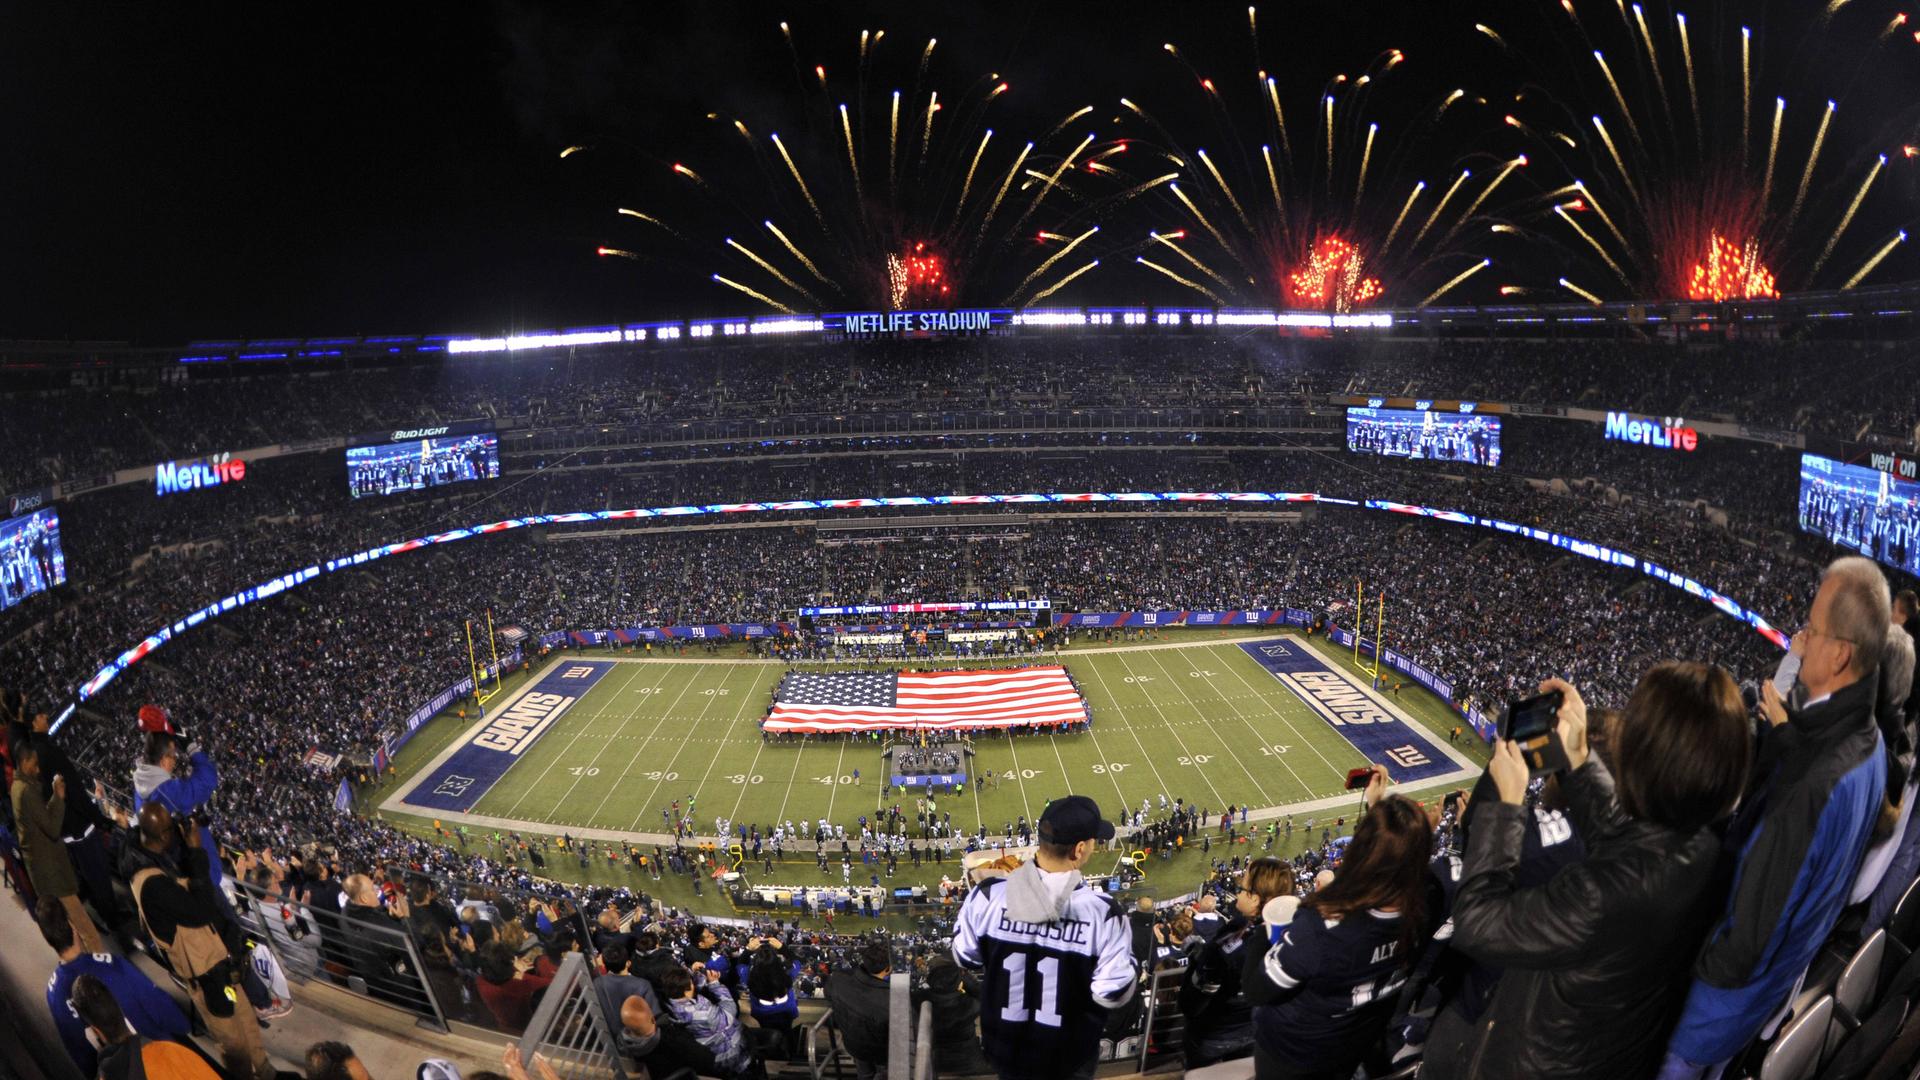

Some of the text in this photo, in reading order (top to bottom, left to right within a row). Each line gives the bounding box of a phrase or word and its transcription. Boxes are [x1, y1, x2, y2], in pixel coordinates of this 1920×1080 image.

[846, 312, 990, 334] METLIFE STADIUM
[1368, 399, 1383, 408] SAP
[1416, 401, 1430, 410] SAP
[1459, 403, 1474, 413] SAP
[418, 427, 449, 438] LIGHT
[1604, 411, 1698, 451] MetLife
[1871, 452, 1917, 478] verizon
[157, 452, 246, 496] MetLife
[1289, 671, 1395, 725] GIANTS
[472, 691, 564, 752] GIANTS
[1258, 744, 1287, 756] 10
[1177, 753, 1208, 766] 20
[570, 766, 600, 777] 10
[1002, 768, 1035, 780] 40
[1092, 763, 1124, 774] 30
[648, 771, 679, 781] 20
[731, 773, 764, 785] 30
[820, 774, 852, 785] 40
[1370, 940, 1399, 965] ALY
[1001, 952, 1062, 1028] 11
